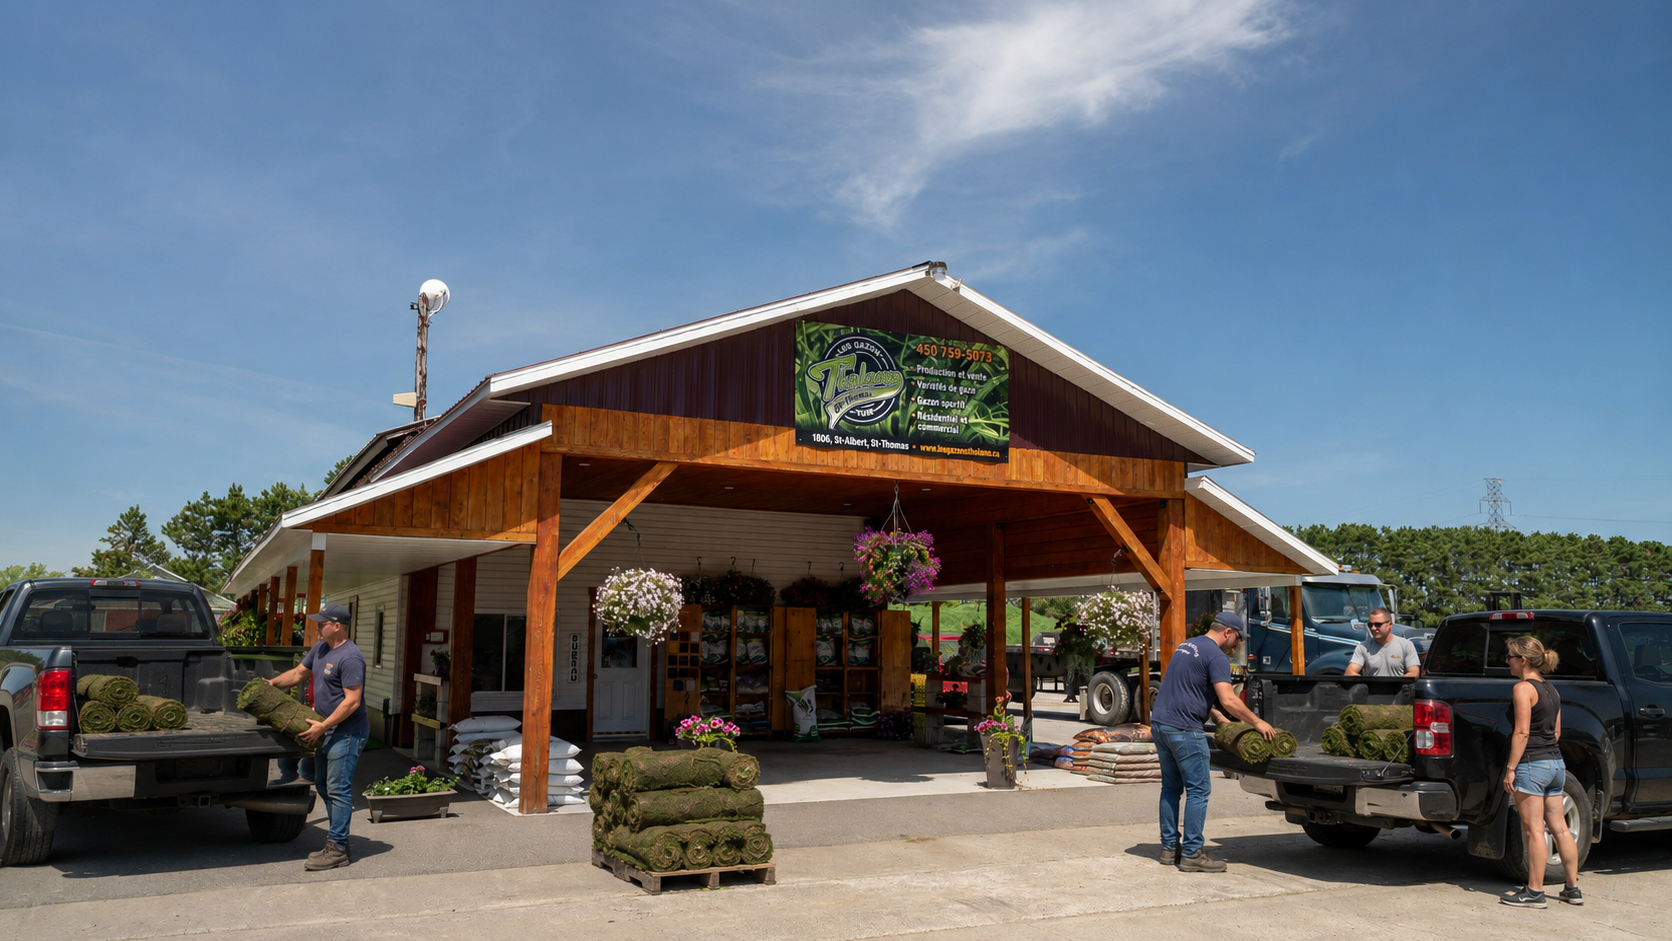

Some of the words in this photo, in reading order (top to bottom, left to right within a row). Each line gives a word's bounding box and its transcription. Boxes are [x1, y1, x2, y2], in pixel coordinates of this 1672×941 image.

[916, 343, 938, 357] 450
[940, 346, 992, 363] 759-5073
[916, 364, 957, 378] Production
[966, 372, 987, 382] vente
[947, 384, 958, 393] de
[916, 396, 940, 407] Gazon
[917, 423, 960, 434] commercial
[812, 433, 833, 446] 1806,
[834, 435, 870, 450] St-Albert,
[870, 438, 910, 451] St-Thomas
